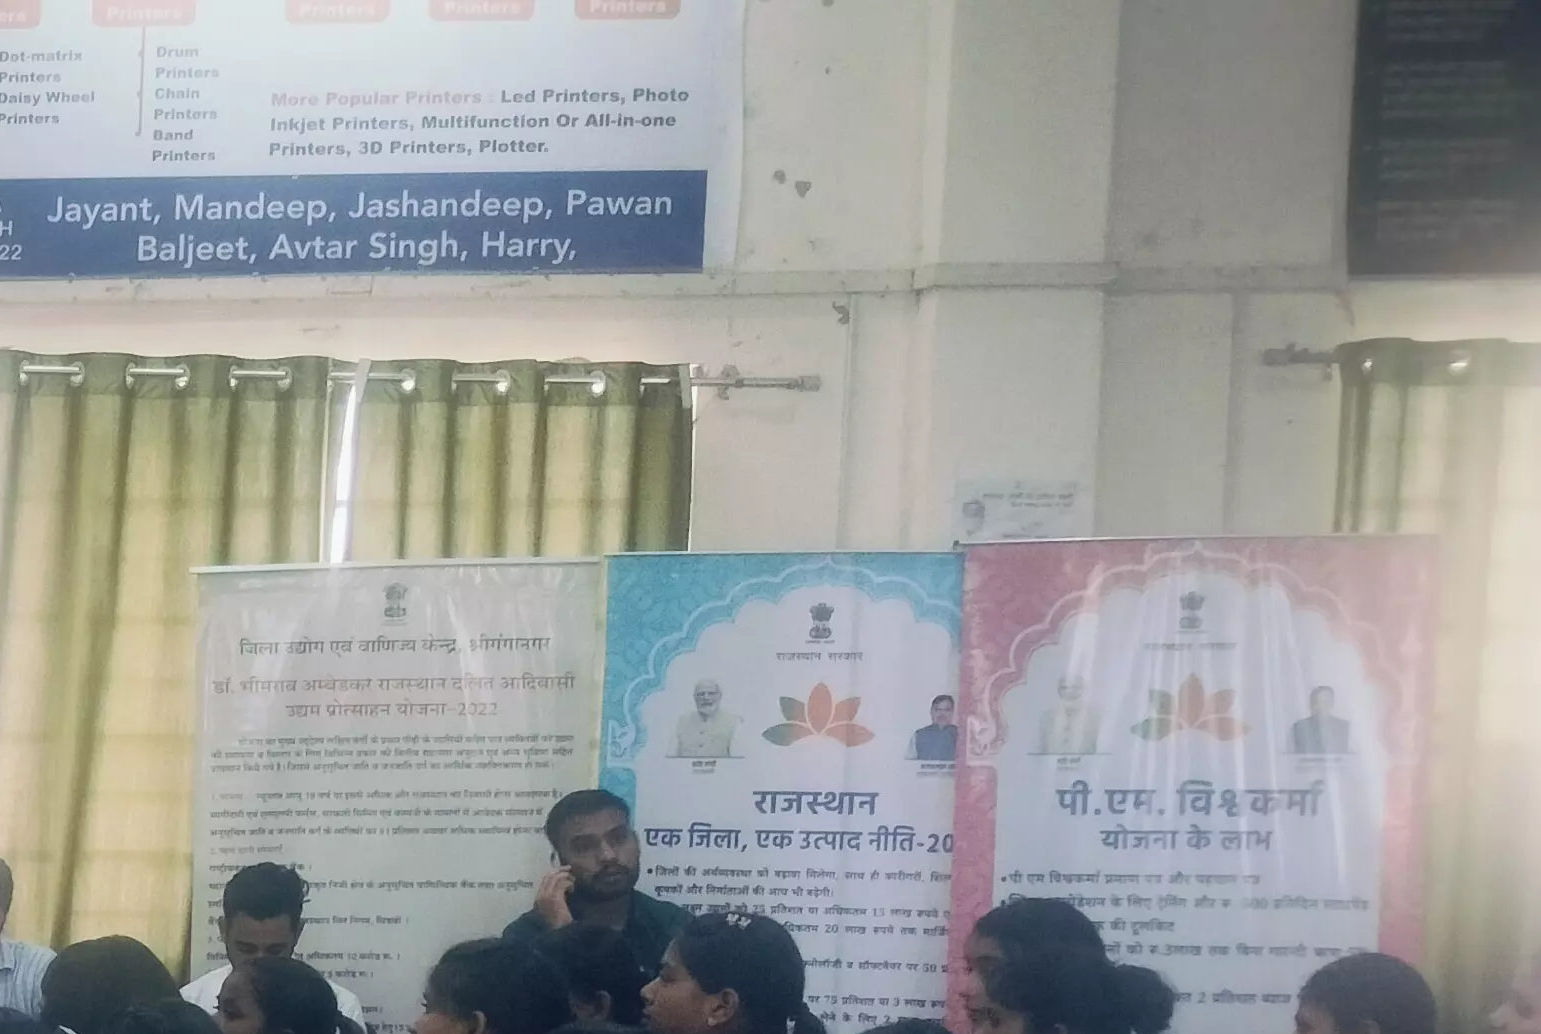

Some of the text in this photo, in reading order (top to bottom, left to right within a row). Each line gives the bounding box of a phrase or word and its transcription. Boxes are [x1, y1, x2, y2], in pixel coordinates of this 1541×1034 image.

[501, 87, 689, 106] Led Printers, Photo
[270, 112, 677, 134] Inkjet Printers, Multifunction All-in-one
[269, 139, 473, 159] Printers, 3D Printers,
[47, 188, 673, 230] Jayant, Mandeep, Jashandeep, Pawan
[137, 229, 577, 269] Baljeet, Avtar Singh, Harry,
[239, 634, 416, 658] जिला उद्योग एवं वाणिज्य
[378, 671, 575, 692] राजस्थान आदिवासी
[285, 702, 320, 719] उद्यम
[326, 700, 390, 718] प्रोत्साहन
[753, 790, 880, 816] राजस्थान
[1055, 779, 1327, 819] पी.एम. विश्वकर्मा
[644, 827, 683, 848] एक
[688, 822, 748, 853] जिला,
[755, 829, 794, 849] एक
[800, 829, 862, 851] उत्पाद
[1100, 823, 1273, 851] योजना के लाभ
